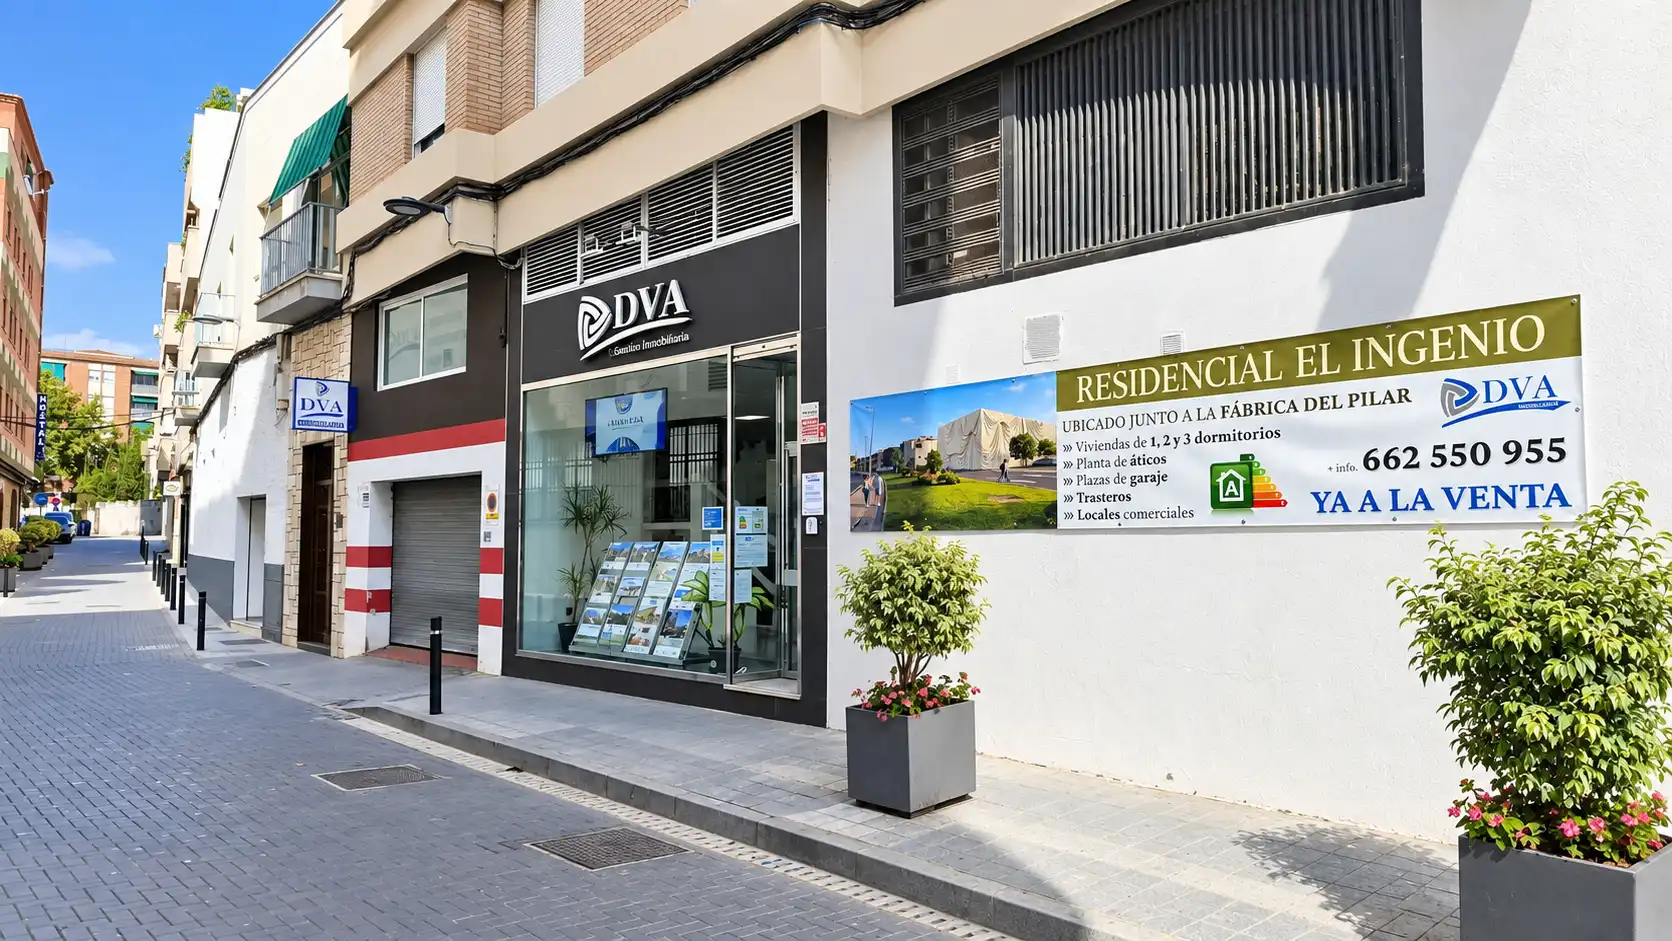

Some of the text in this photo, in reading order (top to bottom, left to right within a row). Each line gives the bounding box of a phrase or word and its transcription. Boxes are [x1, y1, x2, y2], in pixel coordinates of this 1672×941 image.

[612, 279, 690, 329] DVA
[1076, 315, 1546, 404] RESIDENCIAL EL INGENIO
[1482, 374, 1558, 404] DVA
[300, 398, 342, 413] DVA
[1062, 388, 1411, 433] UBICADO JUNTO A LA FÁBRICA DEL PILAR
[1076, 426, 1281, 453] Viviendas de 1, 2 y 3 dormitorios
[1076, 453, 1167, 469] Planta de áticos
[1336, 462, 1358, 473] info.
[1363, 445, 1420, 471] 662
[1430, 441, 1491, 468] 550
[1502, 437, 1567, 465] 955
[1076, 471, 1168, 487] Plazas de garaje
[1225, 480, 1239, 496] A
[1076, 492, 1132, 503] Trasteros
[1310, 483, 1573, 513] YA A LA VENTA
[1077, 506, 1195, 520] Locales comerciales
